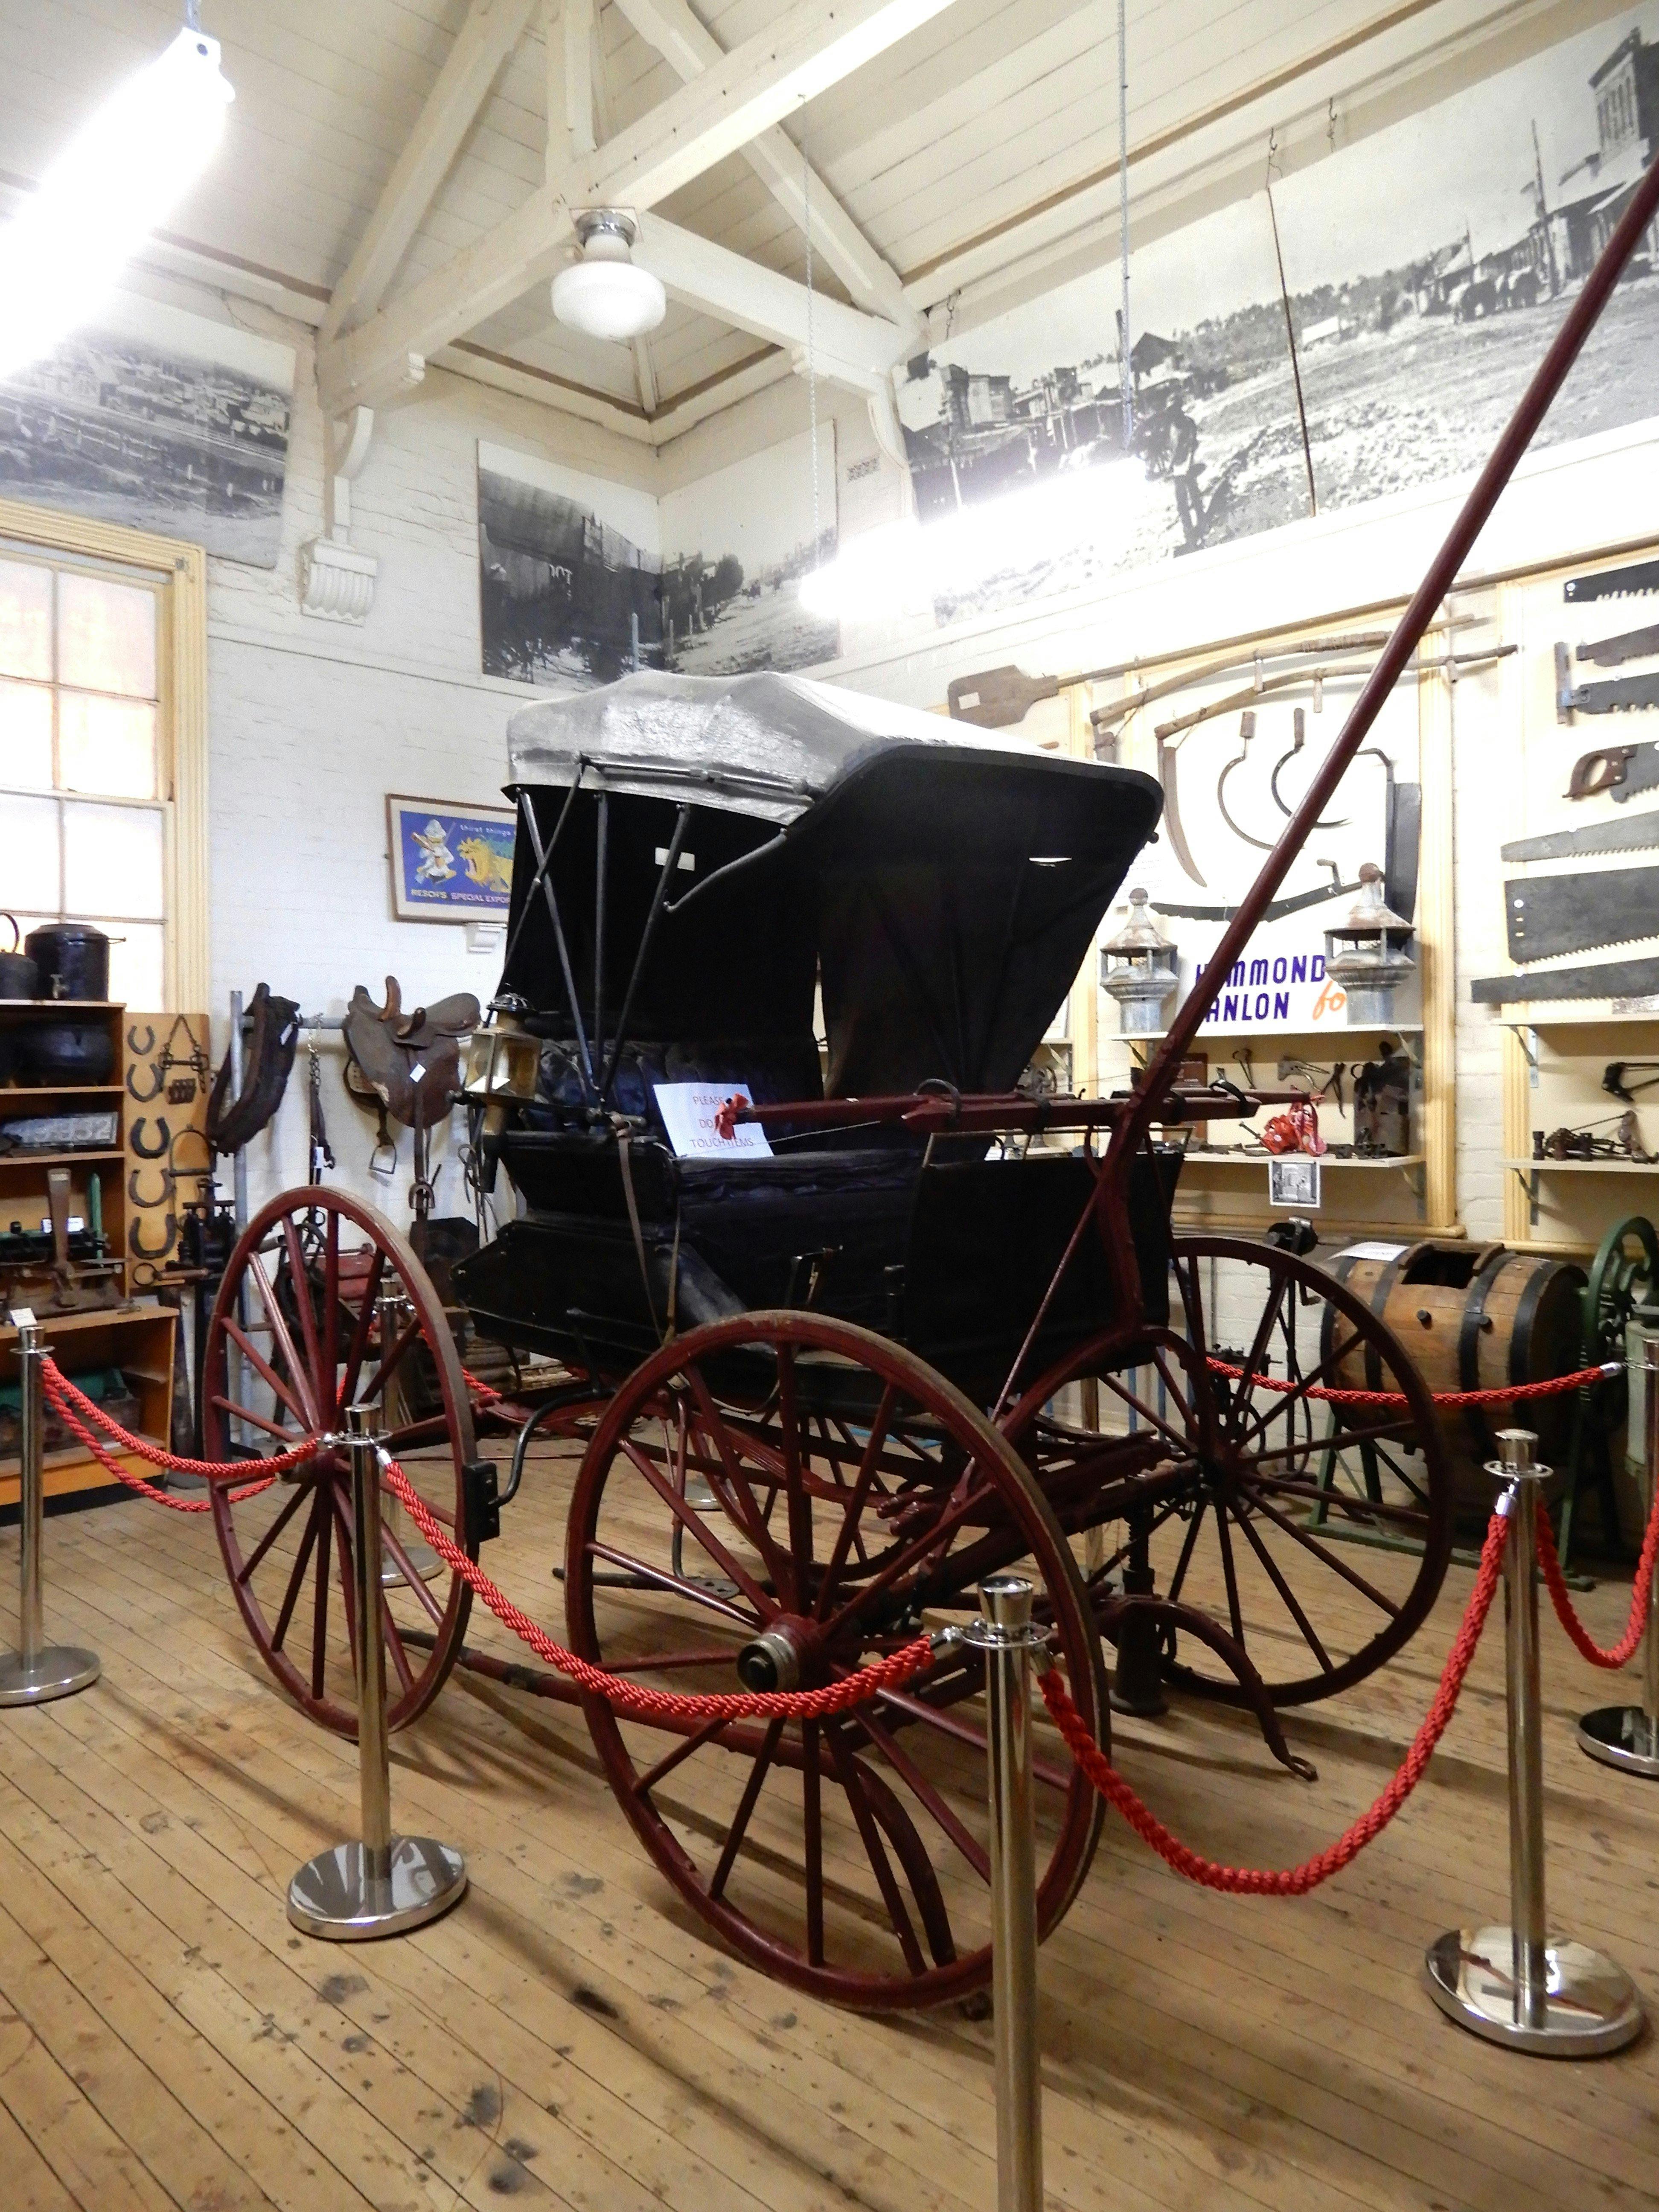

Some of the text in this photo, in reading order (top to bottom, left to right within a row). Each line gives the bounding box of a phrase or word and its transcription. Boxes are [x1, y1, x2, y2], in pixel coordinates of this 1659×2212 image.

[451, 892, 484, 902] SPECIAL
[1312, 980, 1347, 1021] fo
[1205, 992, 1289, 1023] ANLON
[699, 1118, 713, 1128] DO
[690, 1138, 725, 1148] TOUCH
